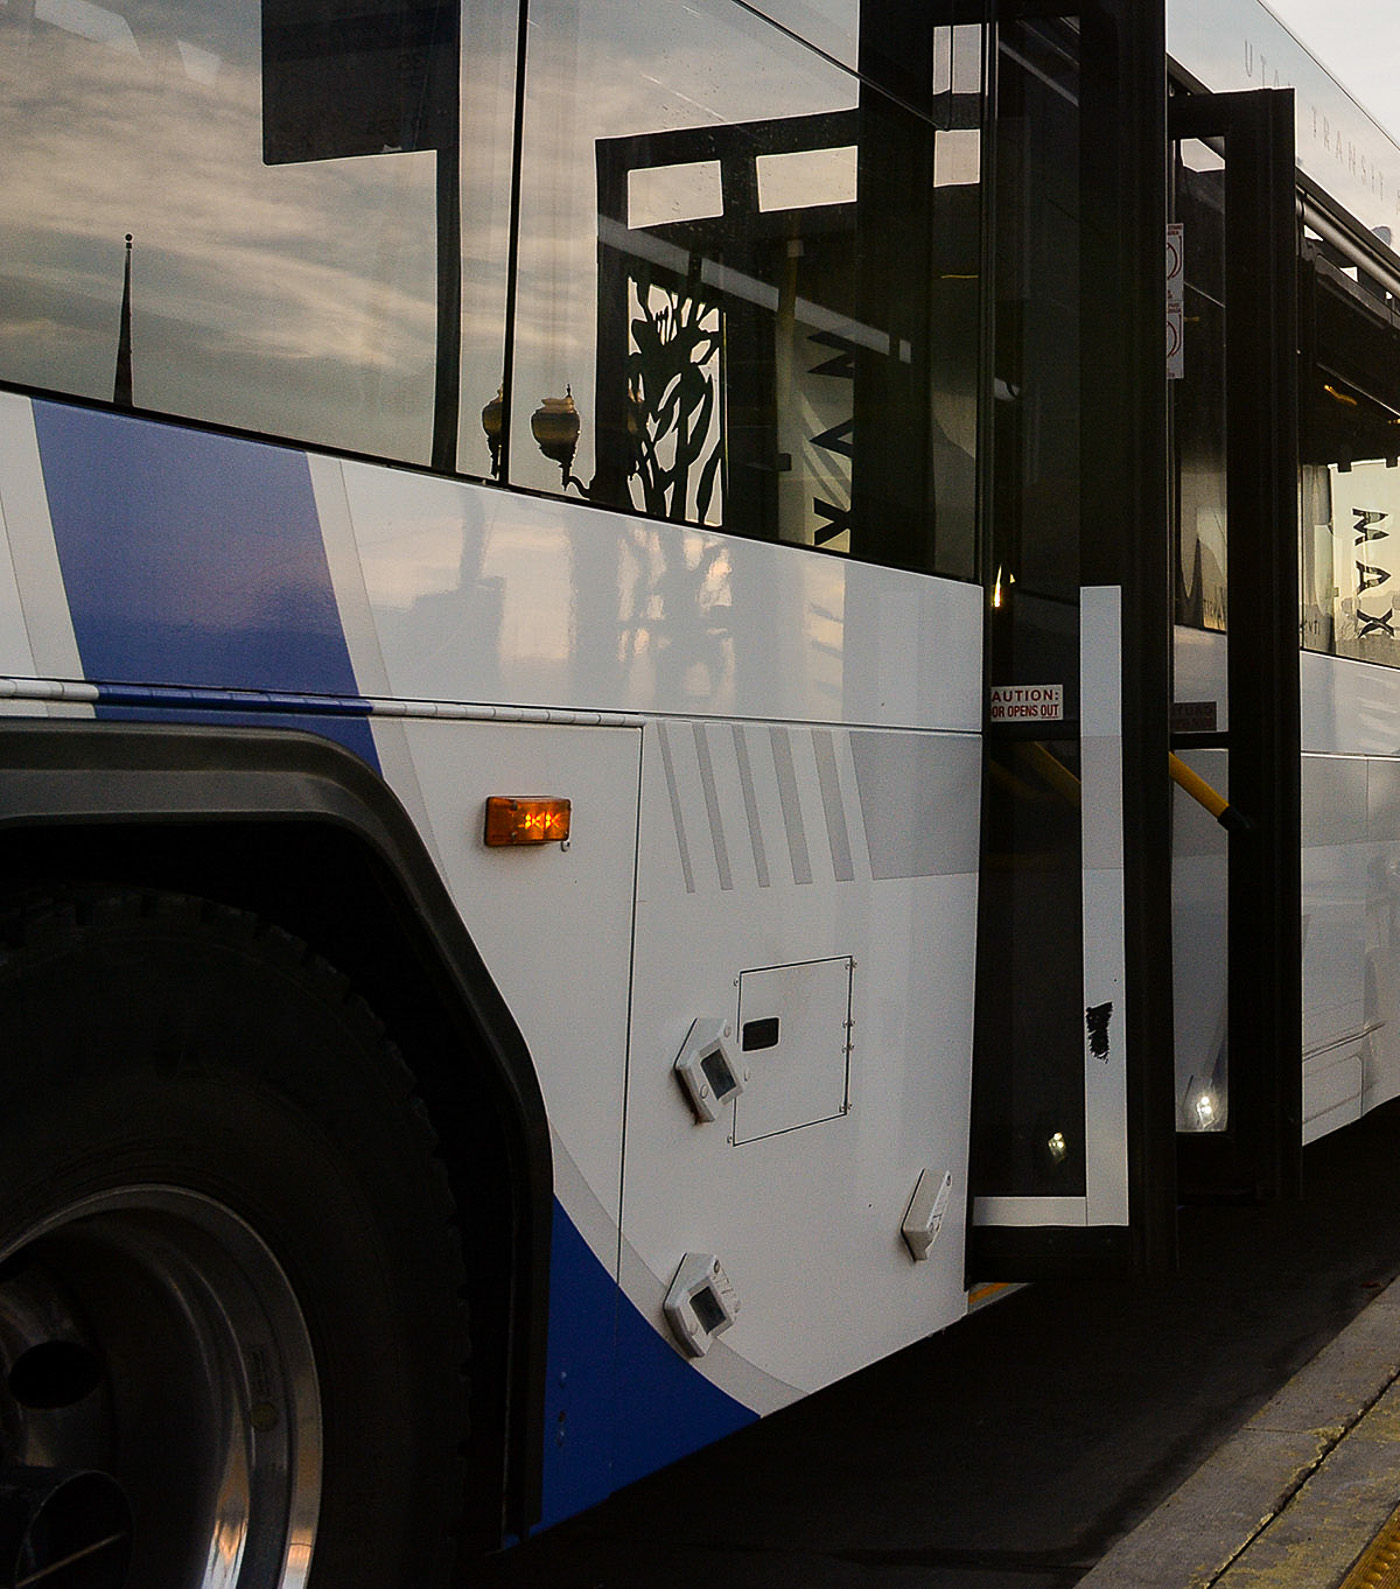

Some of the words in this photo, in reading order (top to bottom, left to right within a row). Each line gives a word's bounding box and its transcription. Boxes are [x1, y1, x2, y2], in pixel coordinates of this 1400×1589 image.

[1244, 39, 1290, 87] UTA
[1311, 105, 1384, 202] TRANSIT
[1352, 508, 1395, 638] MAX
[991, 689, 1059, 702] AUTION:
[992, 705, 1005, 718] OR
[1007, 704, 1038, 718] OPENS
[1040, 703, 1059, 716] OUT
